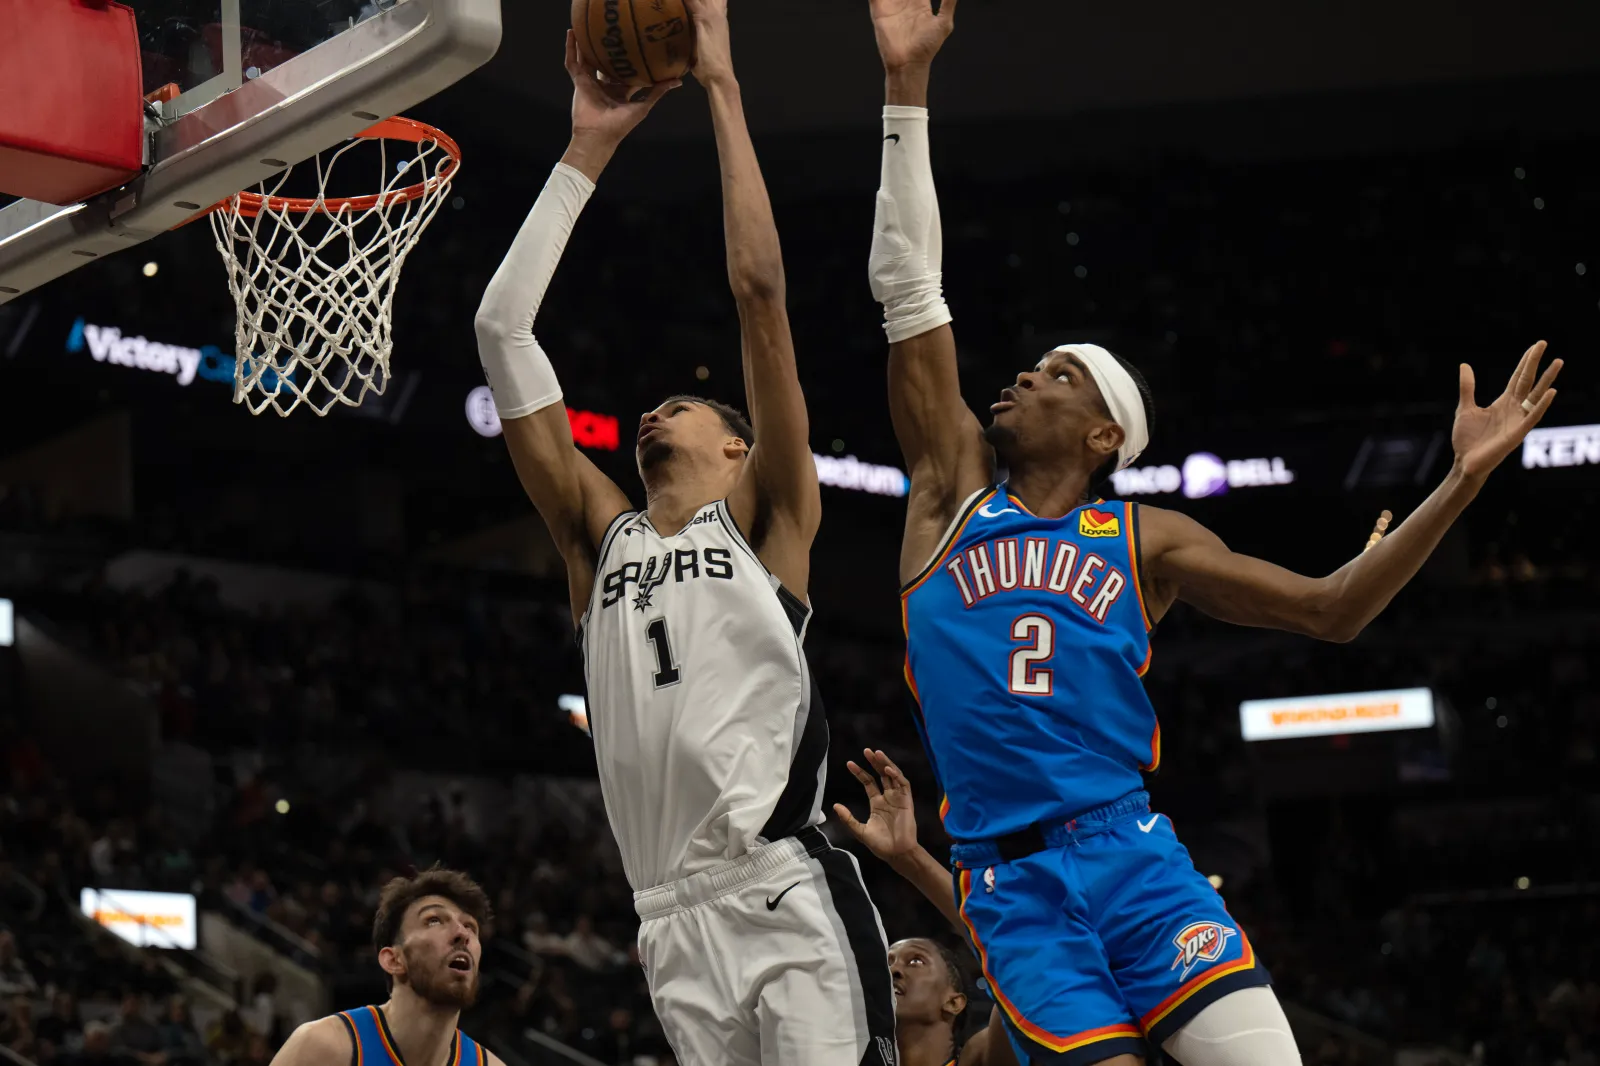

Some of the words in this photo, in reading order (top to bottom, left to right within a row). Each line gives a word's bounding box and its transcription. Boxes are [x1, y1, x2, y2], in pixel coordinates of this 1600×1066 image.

[84, 324, 201, 386] Victory
[1227, 457, 1293, 488] BELL
[690, 510, 718, 526] elf.
[602, 547, 734, 613] SPURS
[946, 537, 1127, 625] THUNDER
[645, 616, 682, 690] 1
[1008, 612, 1055, 697] 2
[1184, 927, 1216, 967] OKC
